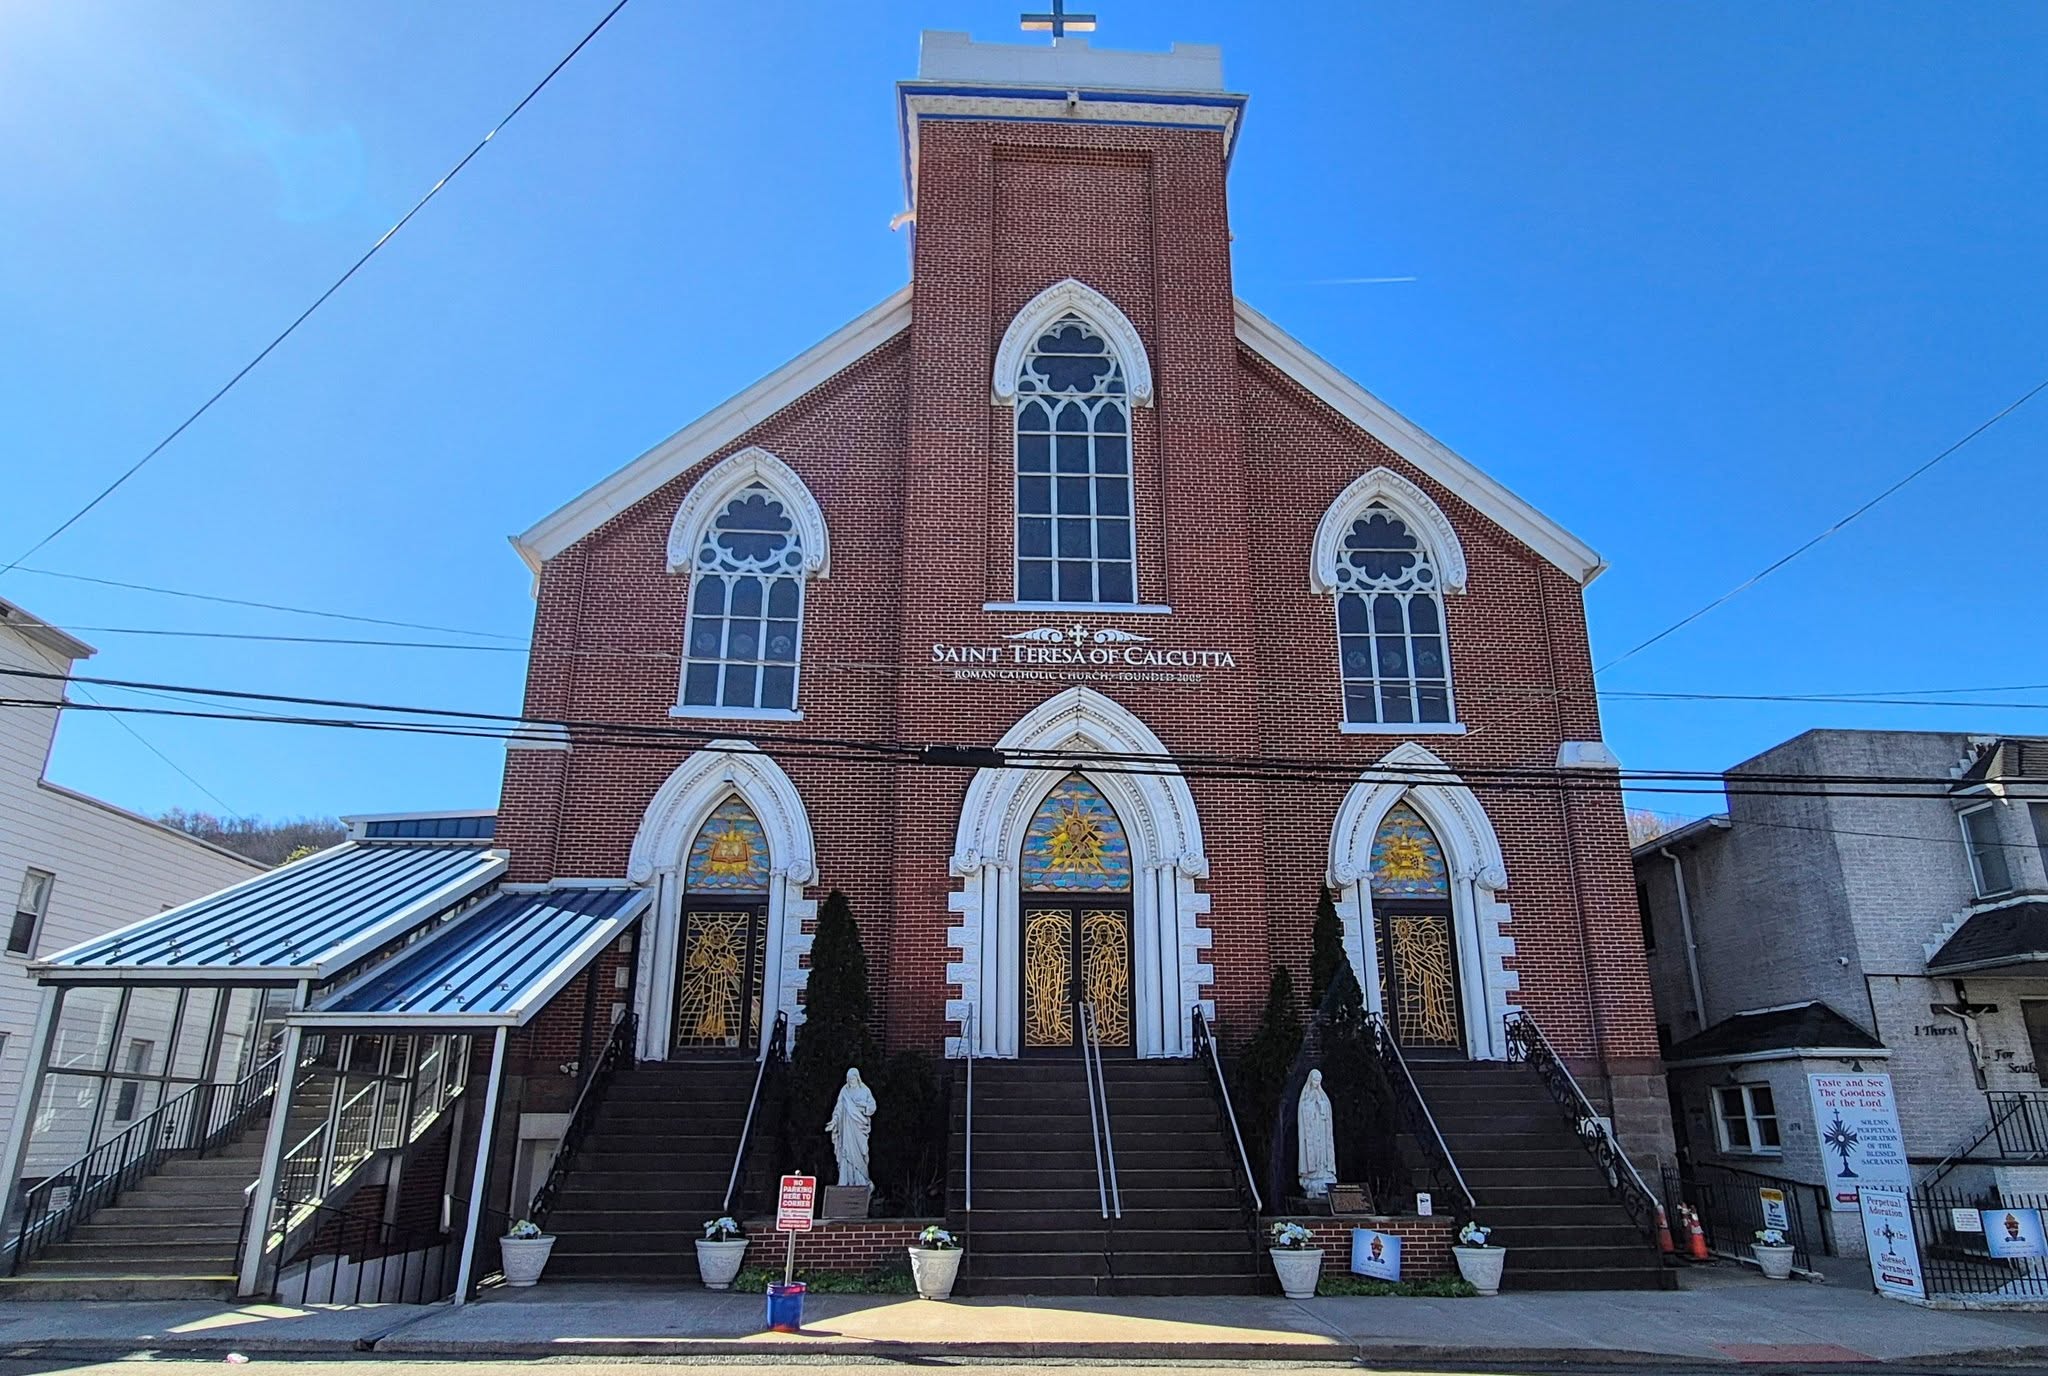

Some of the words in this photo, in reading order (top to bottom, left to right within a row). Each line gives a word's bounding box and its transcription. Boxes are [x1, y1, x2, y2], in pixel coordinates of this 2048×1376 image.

[932, 644, 1002, 663] SAINT
[1008, 645, 1087, 664] TERESA
[1089, 648, 1119, 665] OF
[1124, 647, 1236, 667] CALCUTTA
[955, 670, 997, 680] ROMAN
[1000, 670, 1057, 680] CATHOLIC
[1119, 672, 1175, 682] FOUNDED
[1816, 1079, 1842, 1087] Taste
[1845, 1079, 1864, 1087] and
[1867, 1079, 1884, 1087] See
[1818, 1089, 1837, 1097] The
[1840, 1089, 1886, 1097] Goodness
[1825, 1099, 1836, 1107] of
[1840, 1099, 1856, 1107] the
[1860, 1099, 1882, 1107] Lord
[782, 1200, 811, 1208] CORNER
[1866, 1195, 1902, 1208] Perpetual
[1869, 1206, 1904, 1218] Adoration
[1896, 1231, 1908, 1241] the
[1880, 1253, 1907, 1266] Blessed
[1877, 1262, 1914, 1276] Sacrament
